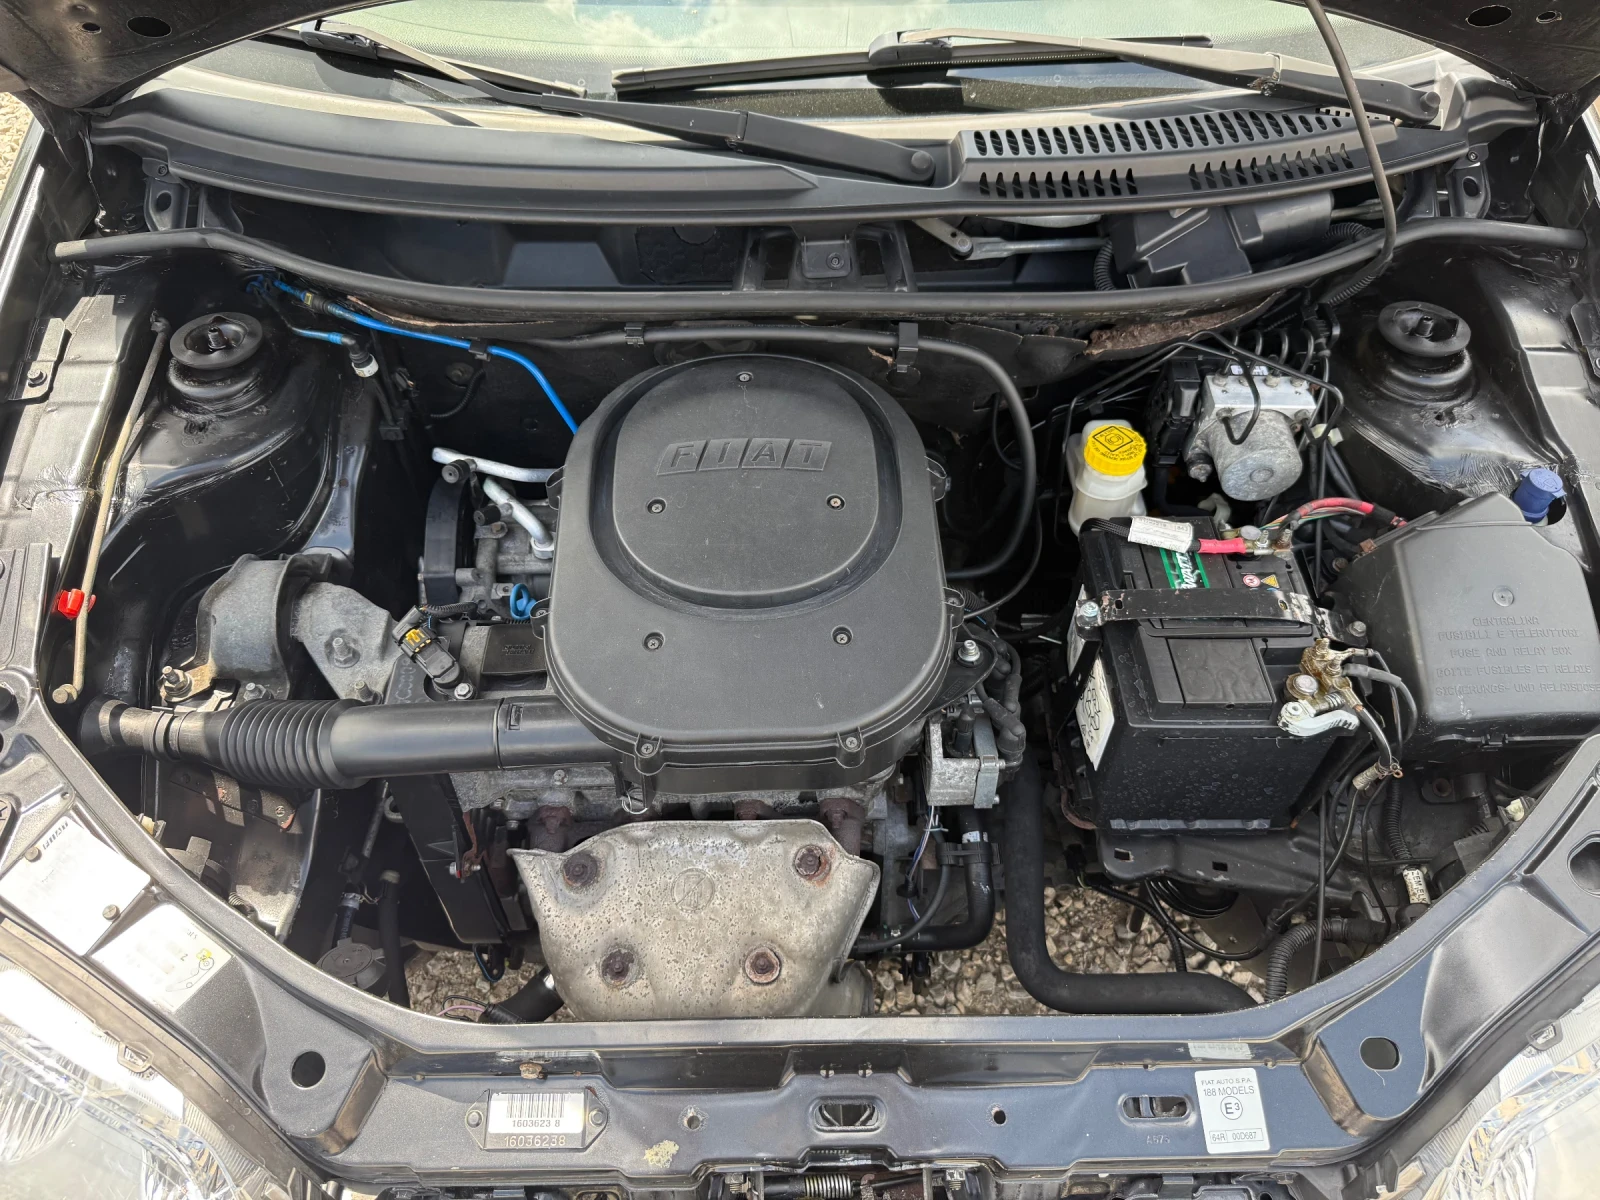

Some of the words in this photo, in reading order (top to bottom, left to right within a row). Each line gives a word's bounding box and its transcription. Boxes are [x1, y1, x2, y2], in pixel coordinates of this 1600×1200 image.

[668, 440, 825, 469] FIAT
[1472, 616, 1540, 627] CENTRALINA
[1437, 629, 1492, 641] FUSIBILI
[1496, 629, 1506, 639] E
[1510, 628, 1580, 638] TELERUTTORI
[1450, 648, 1481, 658] FUSE
[1486, 646, 1507, 657] AND
[1513, 646, 1547, 656] RELAY
[1551, 646, 1573, 656] BOX
[1476, 664, 1532, 676] FUSIBLES
[1536, 664, 1551, 674] ET
[1554, 664, 1592, 674] RELAIS
[1513, 683, 1536, 693] UND
[1203, 1087, 1217, 1097] 188
[1217, 1085, 1255, 1096] MODELS
[504, 1135, 566, 1147] 16036238
